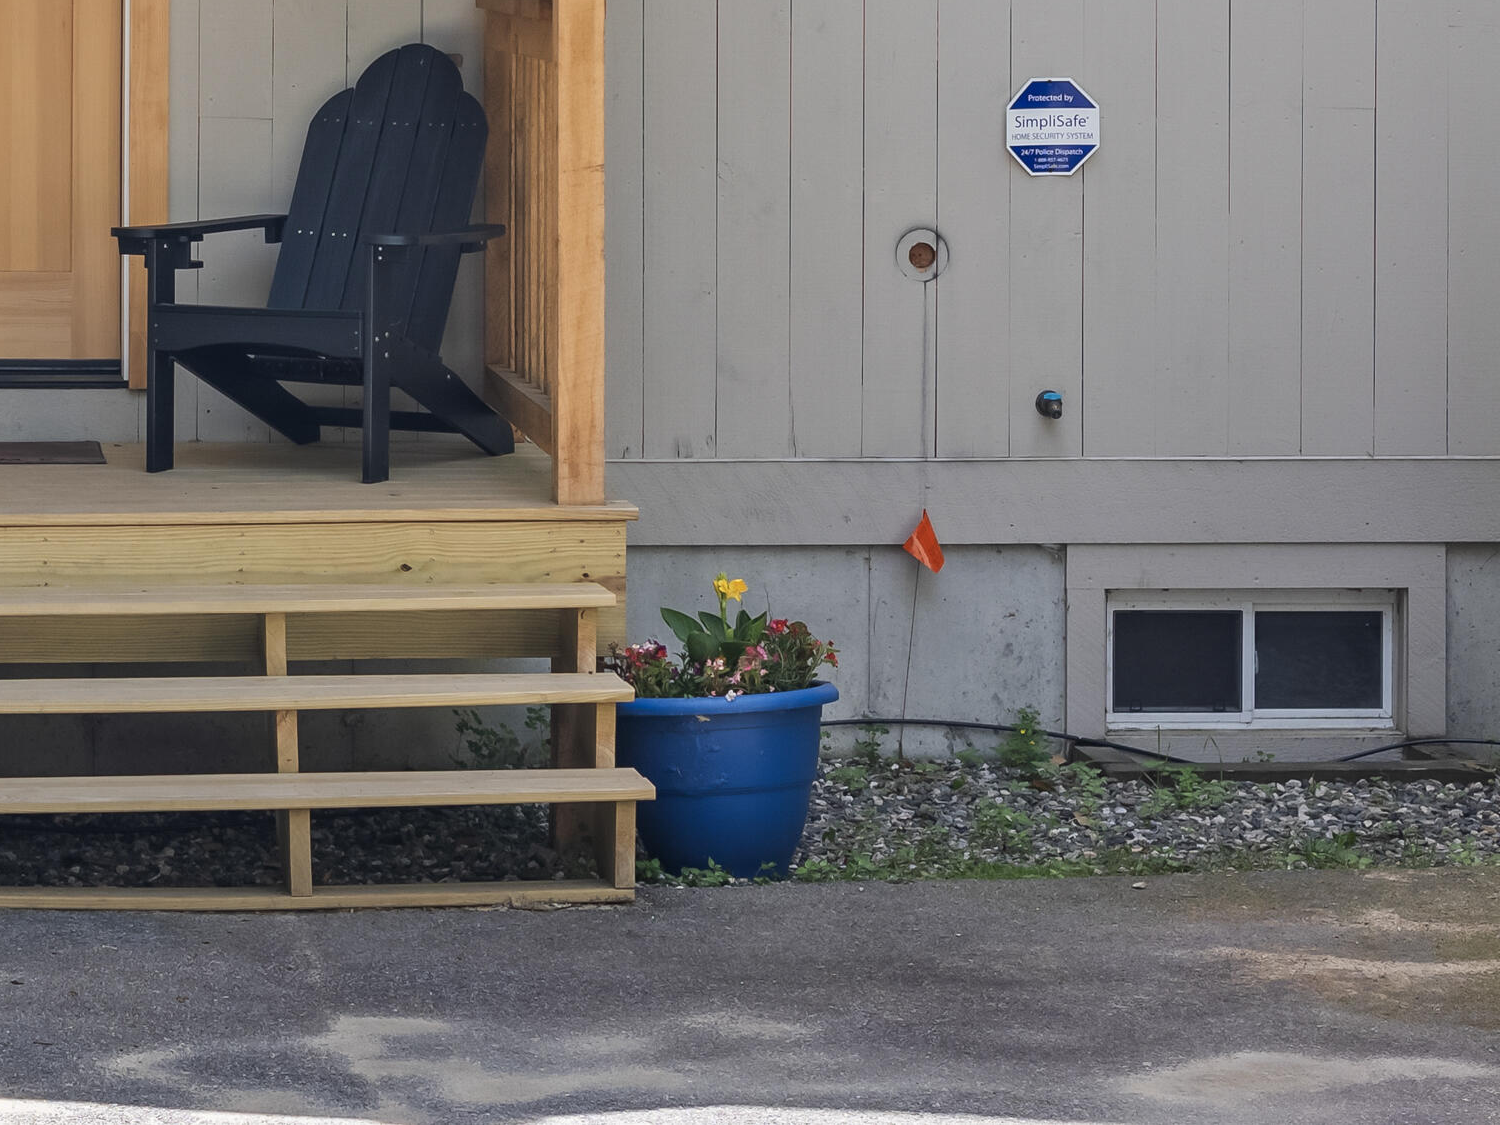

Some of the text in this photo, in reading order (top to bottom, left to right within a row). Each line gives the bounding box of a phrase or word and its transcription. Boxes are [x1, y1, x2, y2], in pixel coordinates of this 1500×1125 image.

[1028, 94, 1074, 103] Protected by
[1015, 115, 1088, 130] SimpliSafe
[1054, 148, 1083, 156] Dispatch
